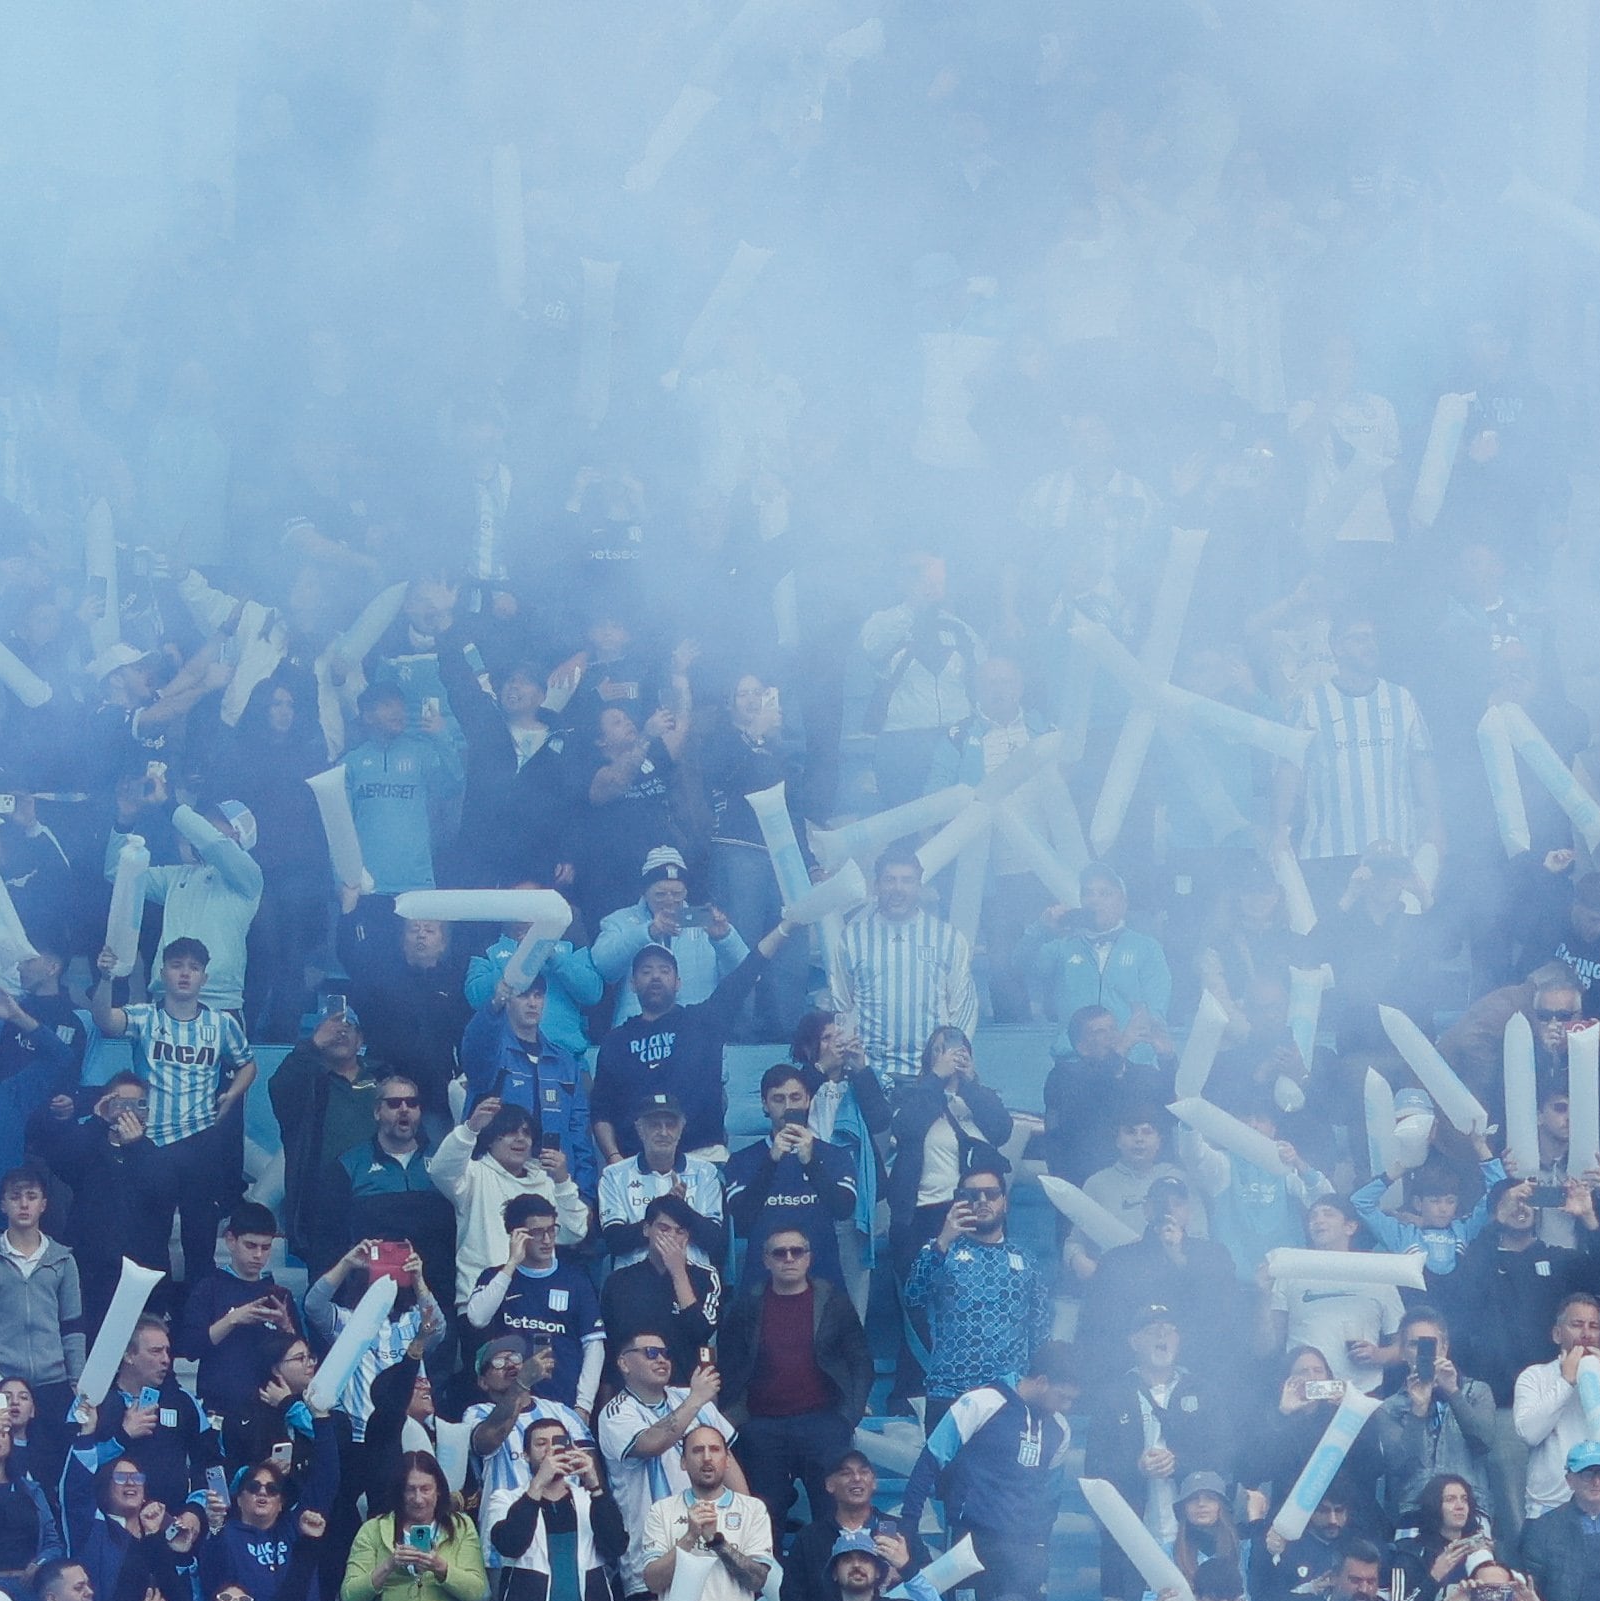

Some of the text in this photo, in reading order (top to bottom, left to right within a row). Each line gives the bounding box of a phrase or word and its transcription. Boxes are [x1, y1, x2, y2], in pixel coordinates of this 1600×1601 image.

[151, 1039, 216, 1066] RCA
[638, 1046, 671, 1063] CLUB
[765, 1194, 818, 1207] etsson
[503, 1313, 566, 1334] betsson
